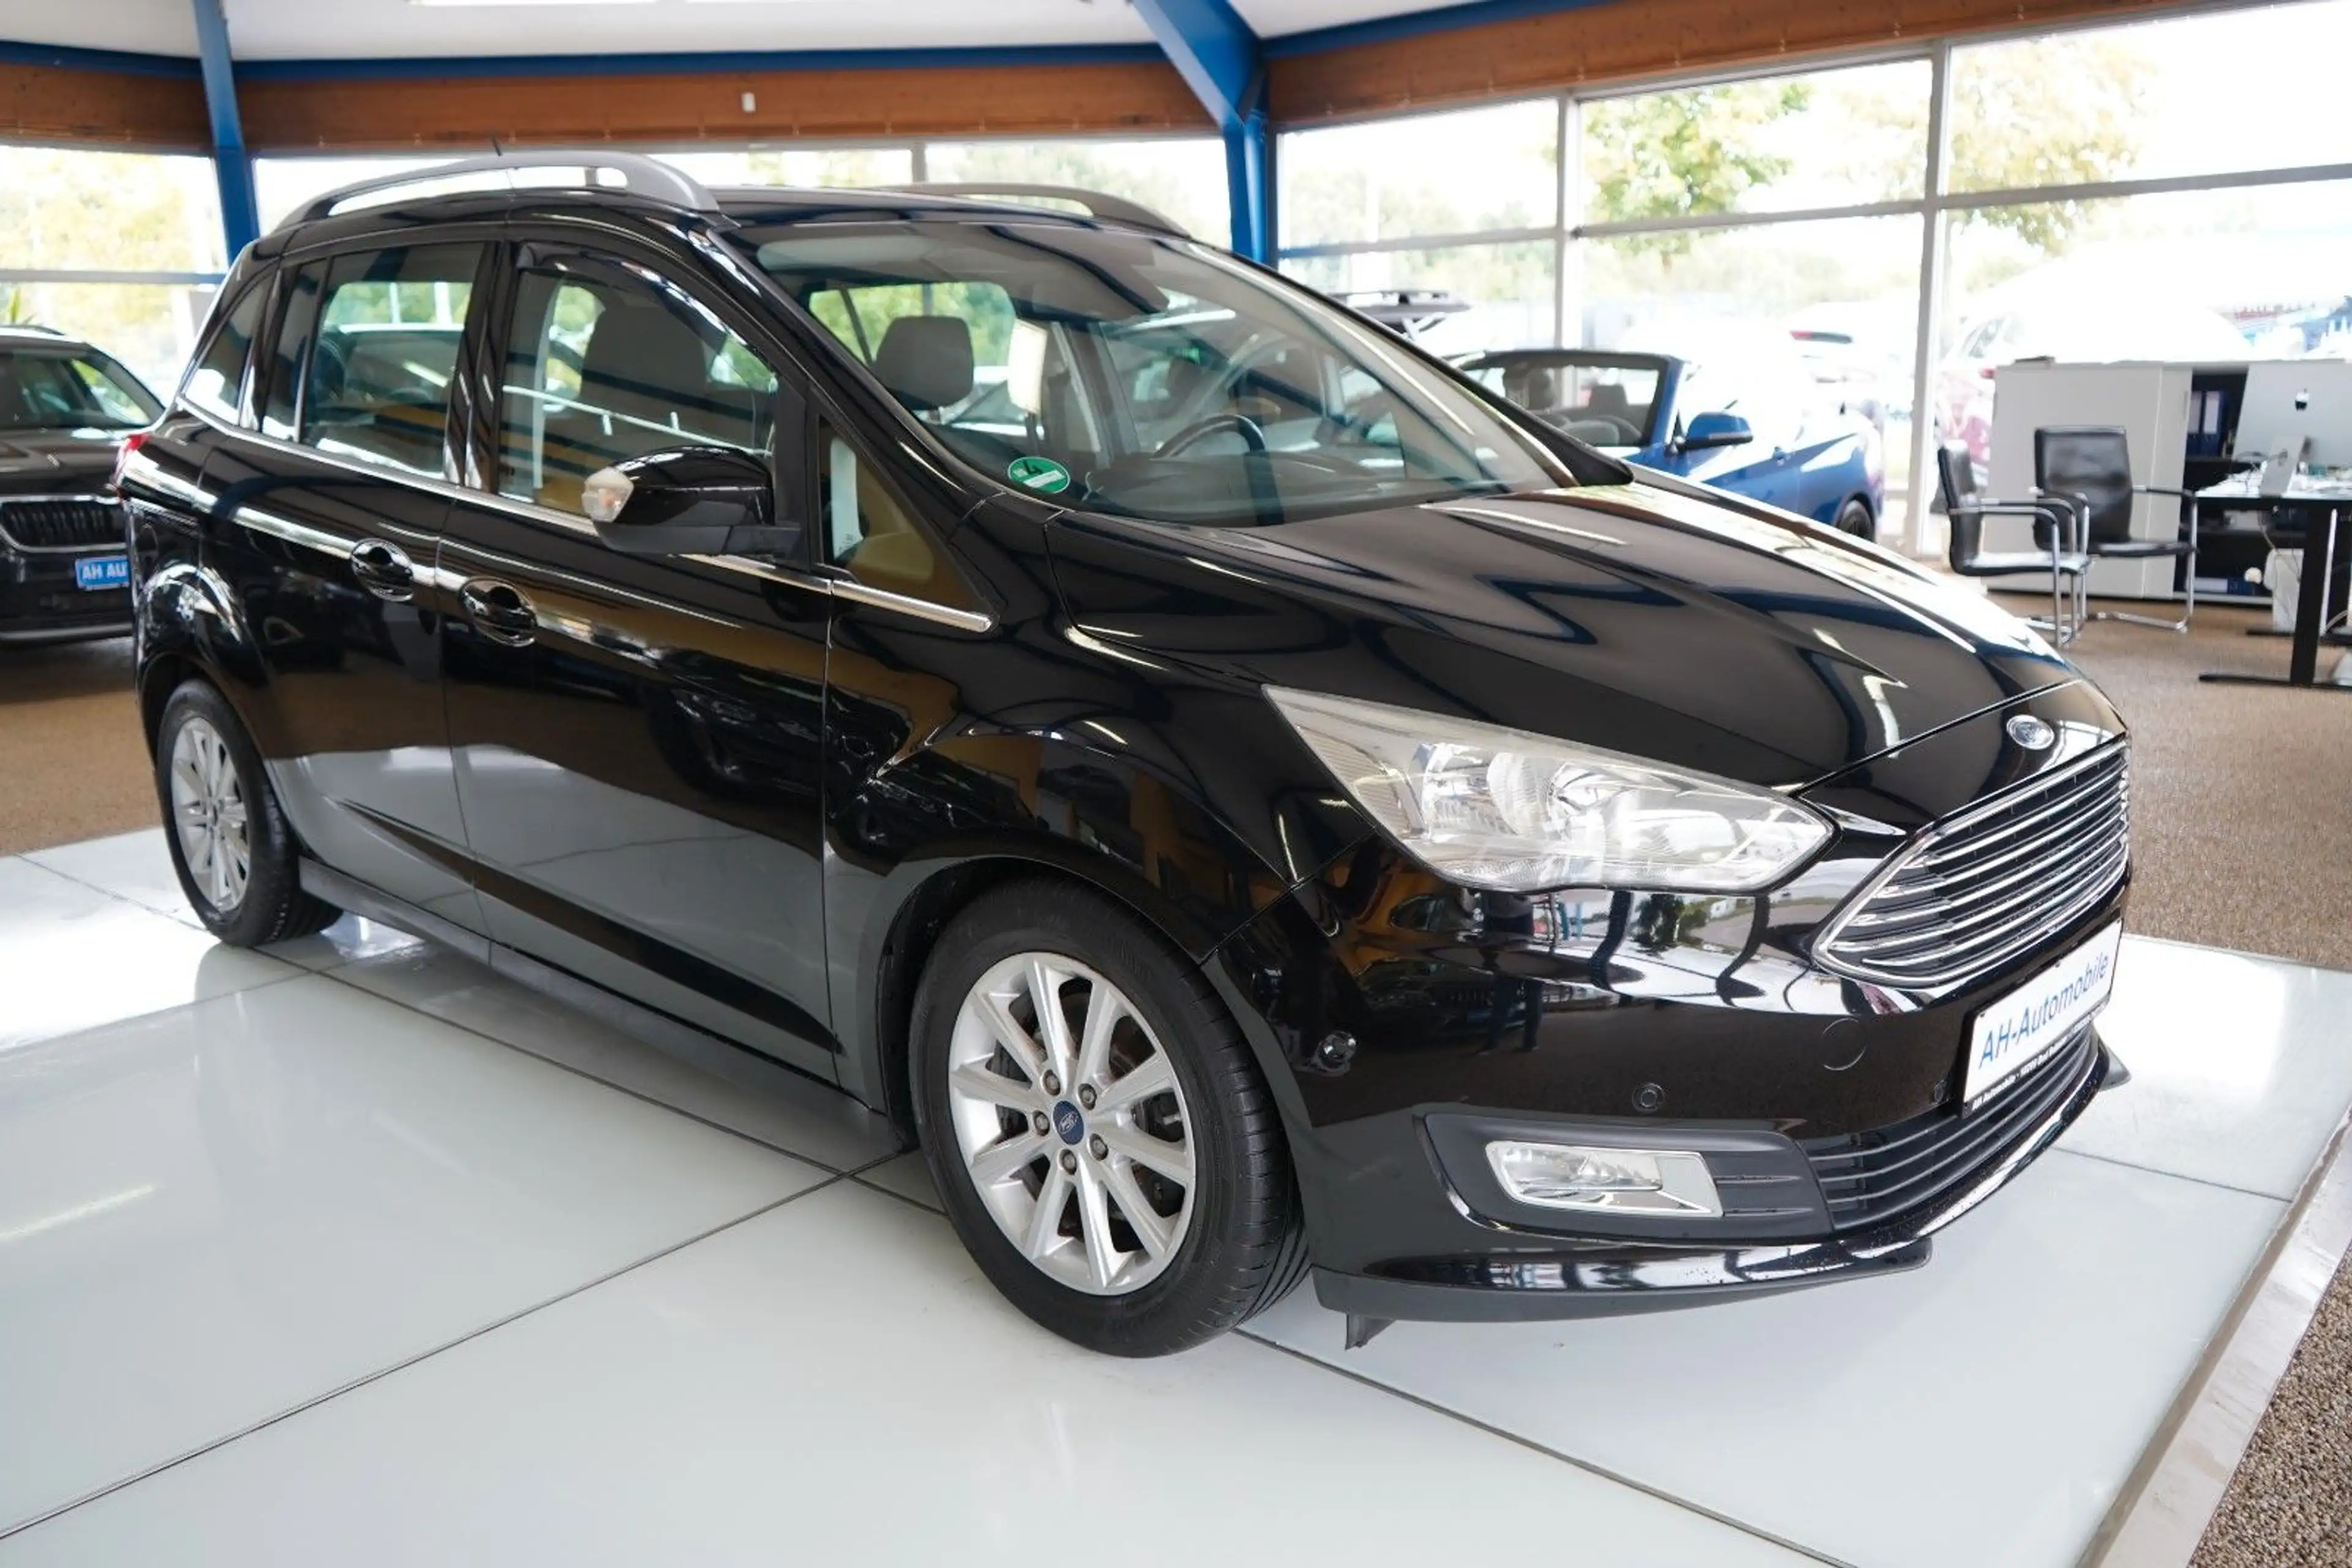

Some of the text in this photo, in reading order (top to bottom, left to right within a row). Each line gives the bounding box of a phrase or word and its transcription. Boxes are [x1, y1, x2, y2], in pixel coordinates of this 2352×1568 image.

[1023, 460, 1043, 475] 4
[82, 562, 128, 581] AH AU
[1978, 952, 2109, 1070] AH-Automobile
